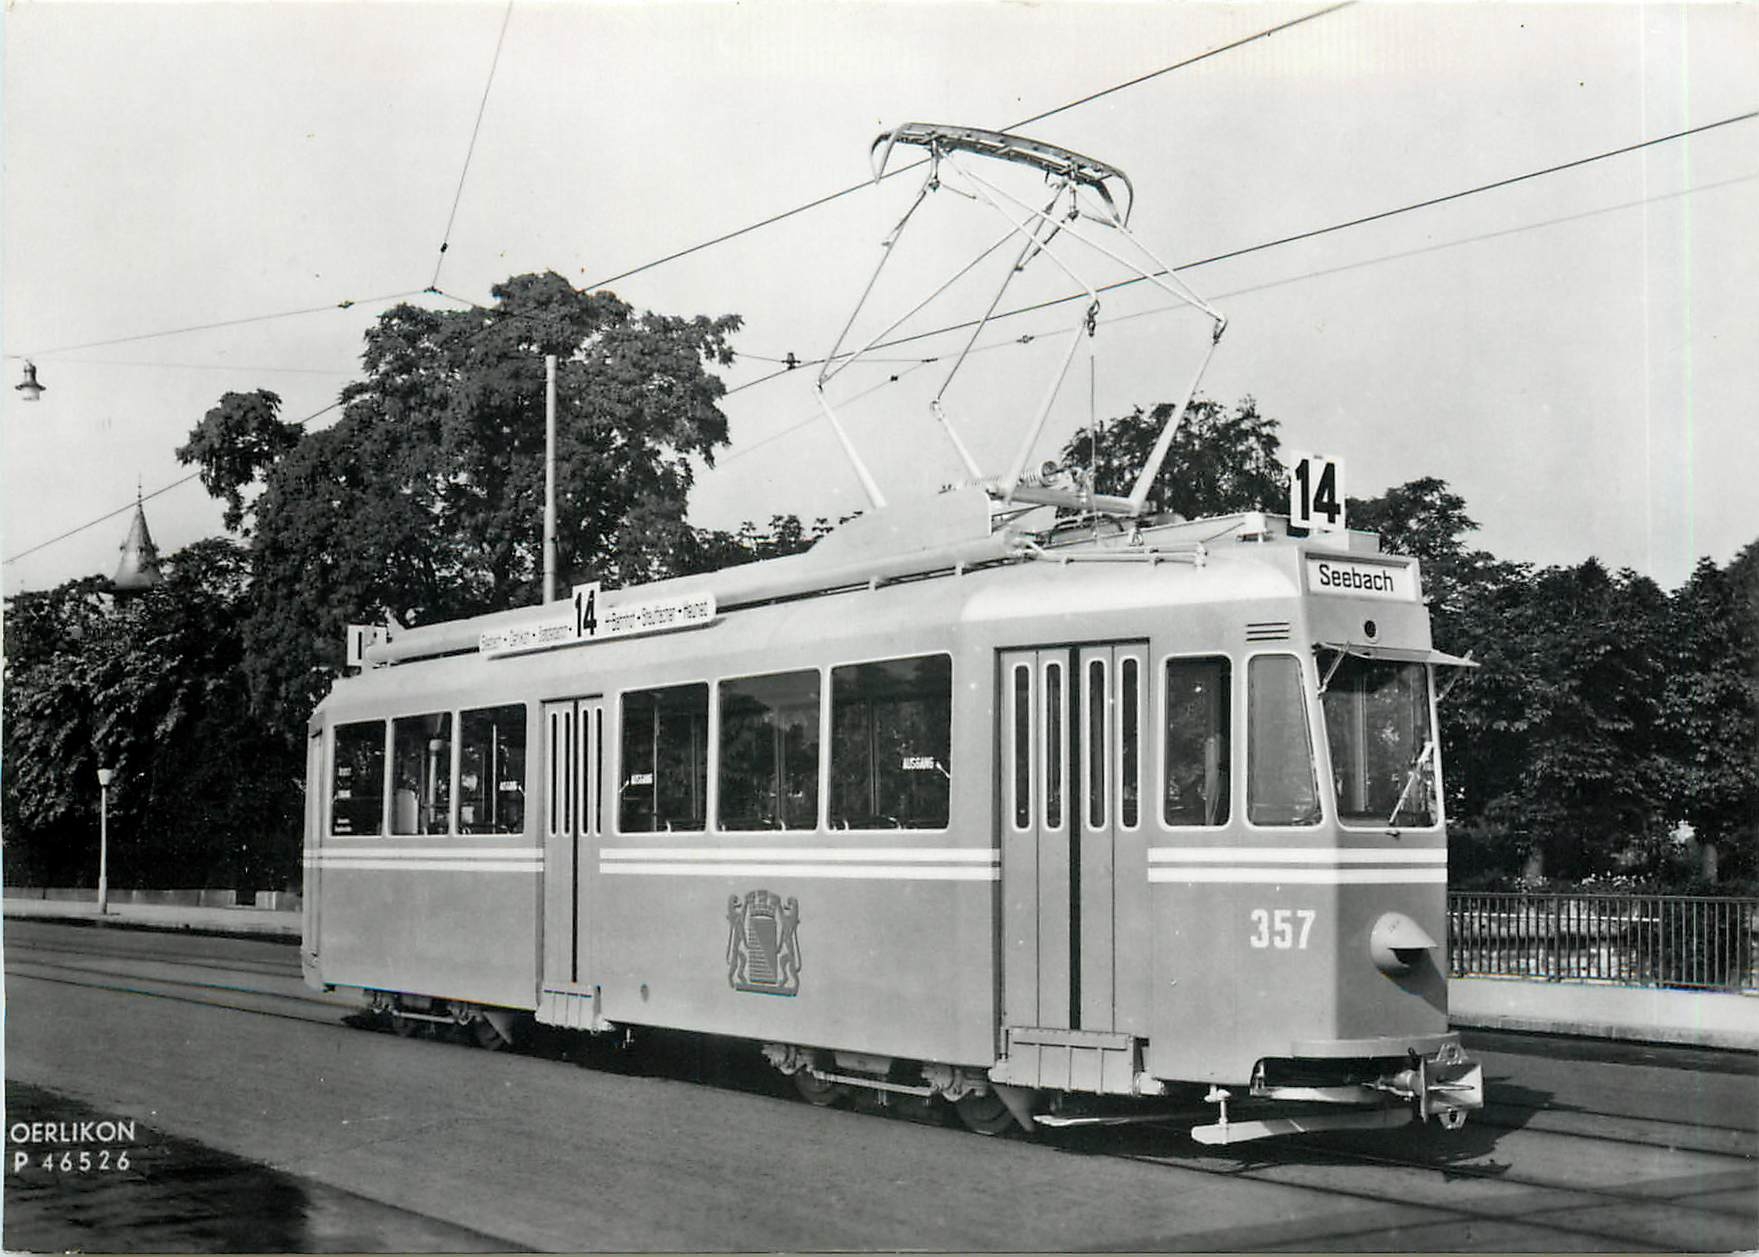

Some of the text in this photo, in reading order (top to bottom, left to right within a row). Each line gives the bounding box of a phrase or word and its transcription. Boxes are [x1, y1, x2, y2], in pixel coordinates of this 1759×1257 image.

[1295, 458, 1342, 524] 14
[1318, 563, 1395, 593] Seebach
[574, 589, 598, 638] 14
[1249, 908, 1317, 950] 357
